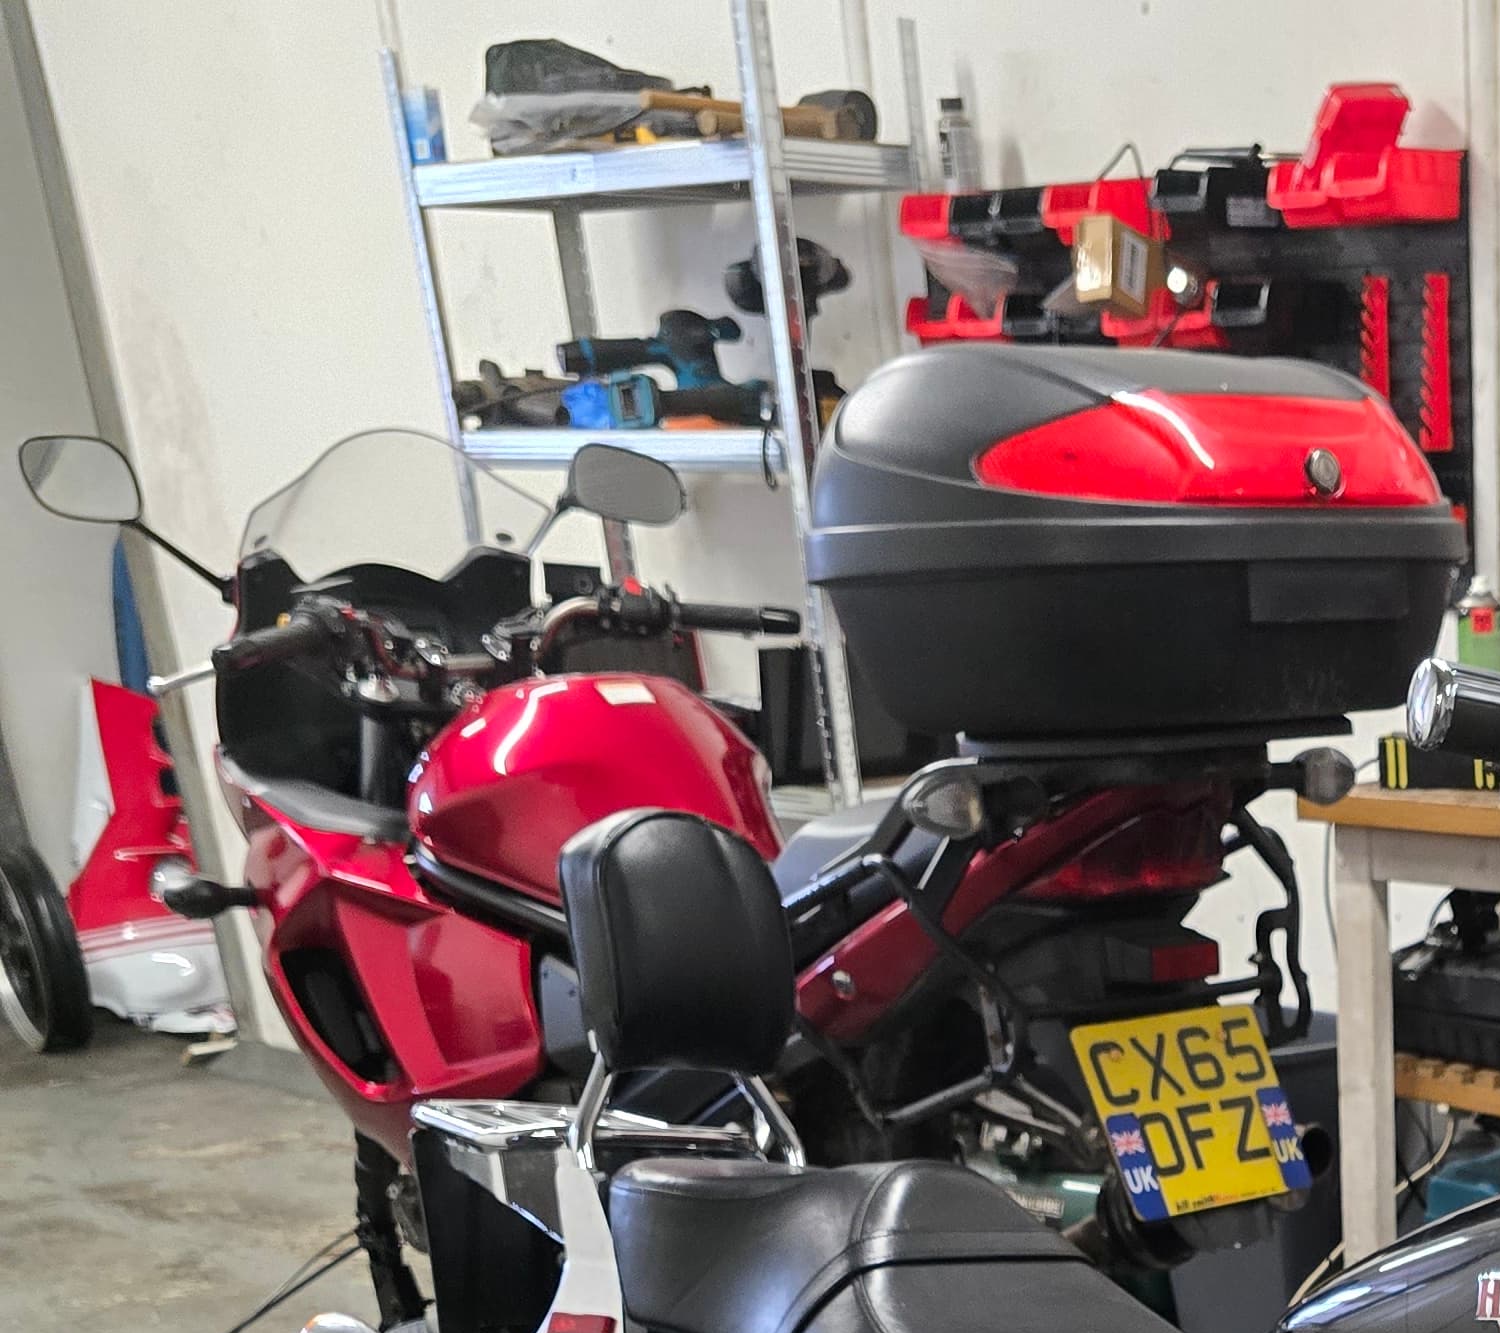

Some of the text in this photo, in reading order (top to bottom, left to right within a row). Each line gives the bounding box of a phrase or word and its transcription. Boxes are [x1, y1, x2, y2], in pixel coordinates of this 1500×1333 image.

[1088, 1017, 1267, 1107] CX65
[1273, 1138, 1305, 1164] UK
[1124, 1165, 1160, 1195] UK
